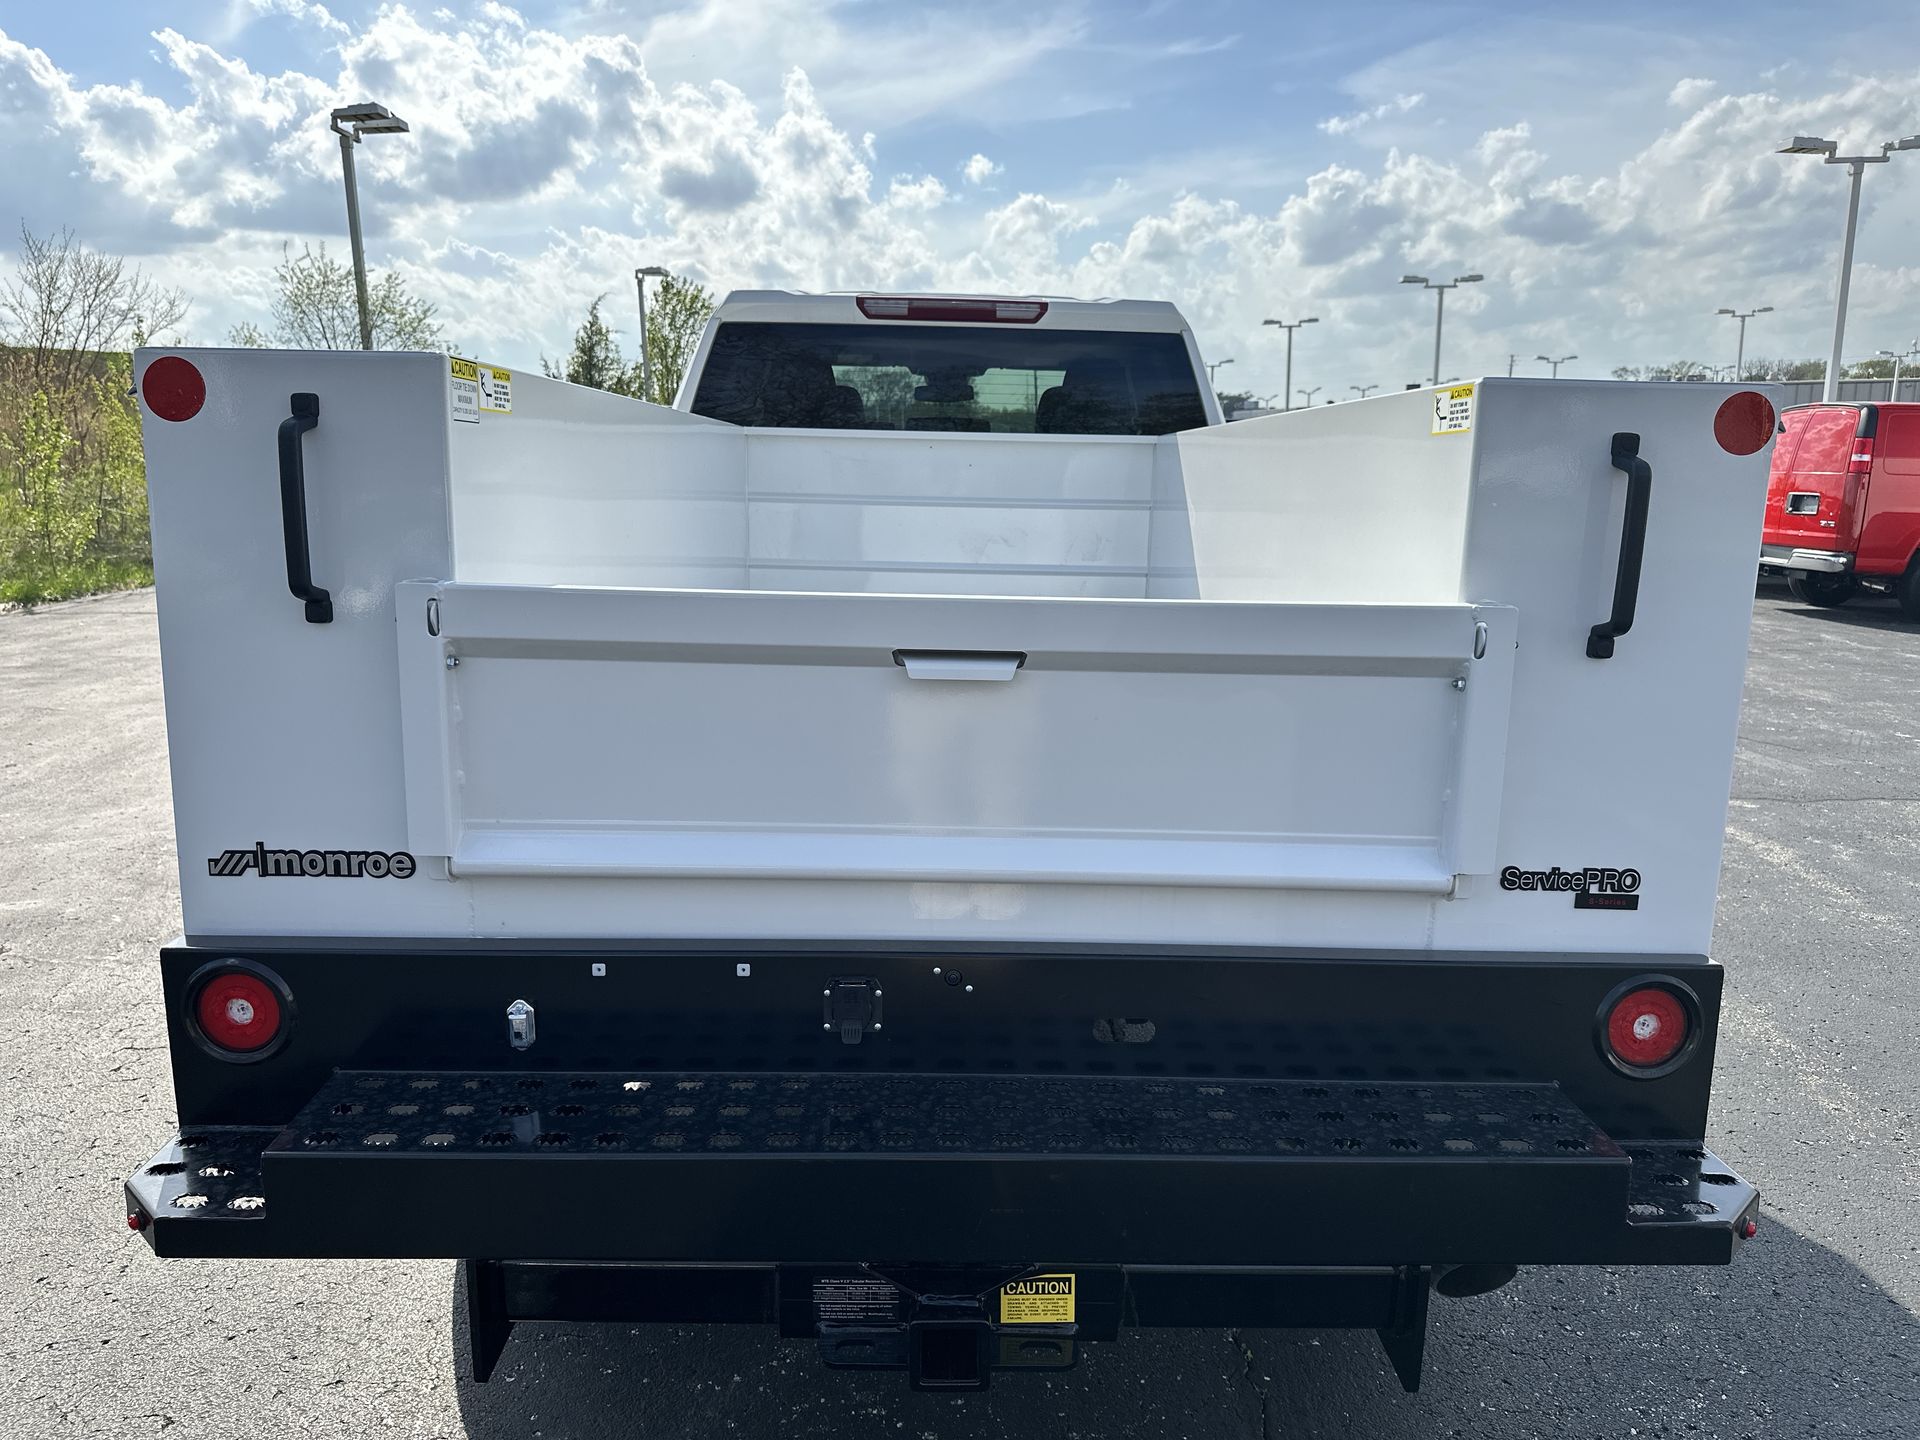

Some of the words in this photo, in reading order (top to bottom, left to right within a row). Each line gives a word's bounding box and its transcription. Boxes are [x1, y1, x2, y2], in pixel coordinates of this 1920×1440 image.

[454, 361, 477, 378] CAUTION
[1454, 388, 1473, 398] CAUTION
[266, 849, 416, 879] monroe
[1501, 865, 1641, 893] ServicePRO
[1006, 1281, 1069, 1294] CAUTION
